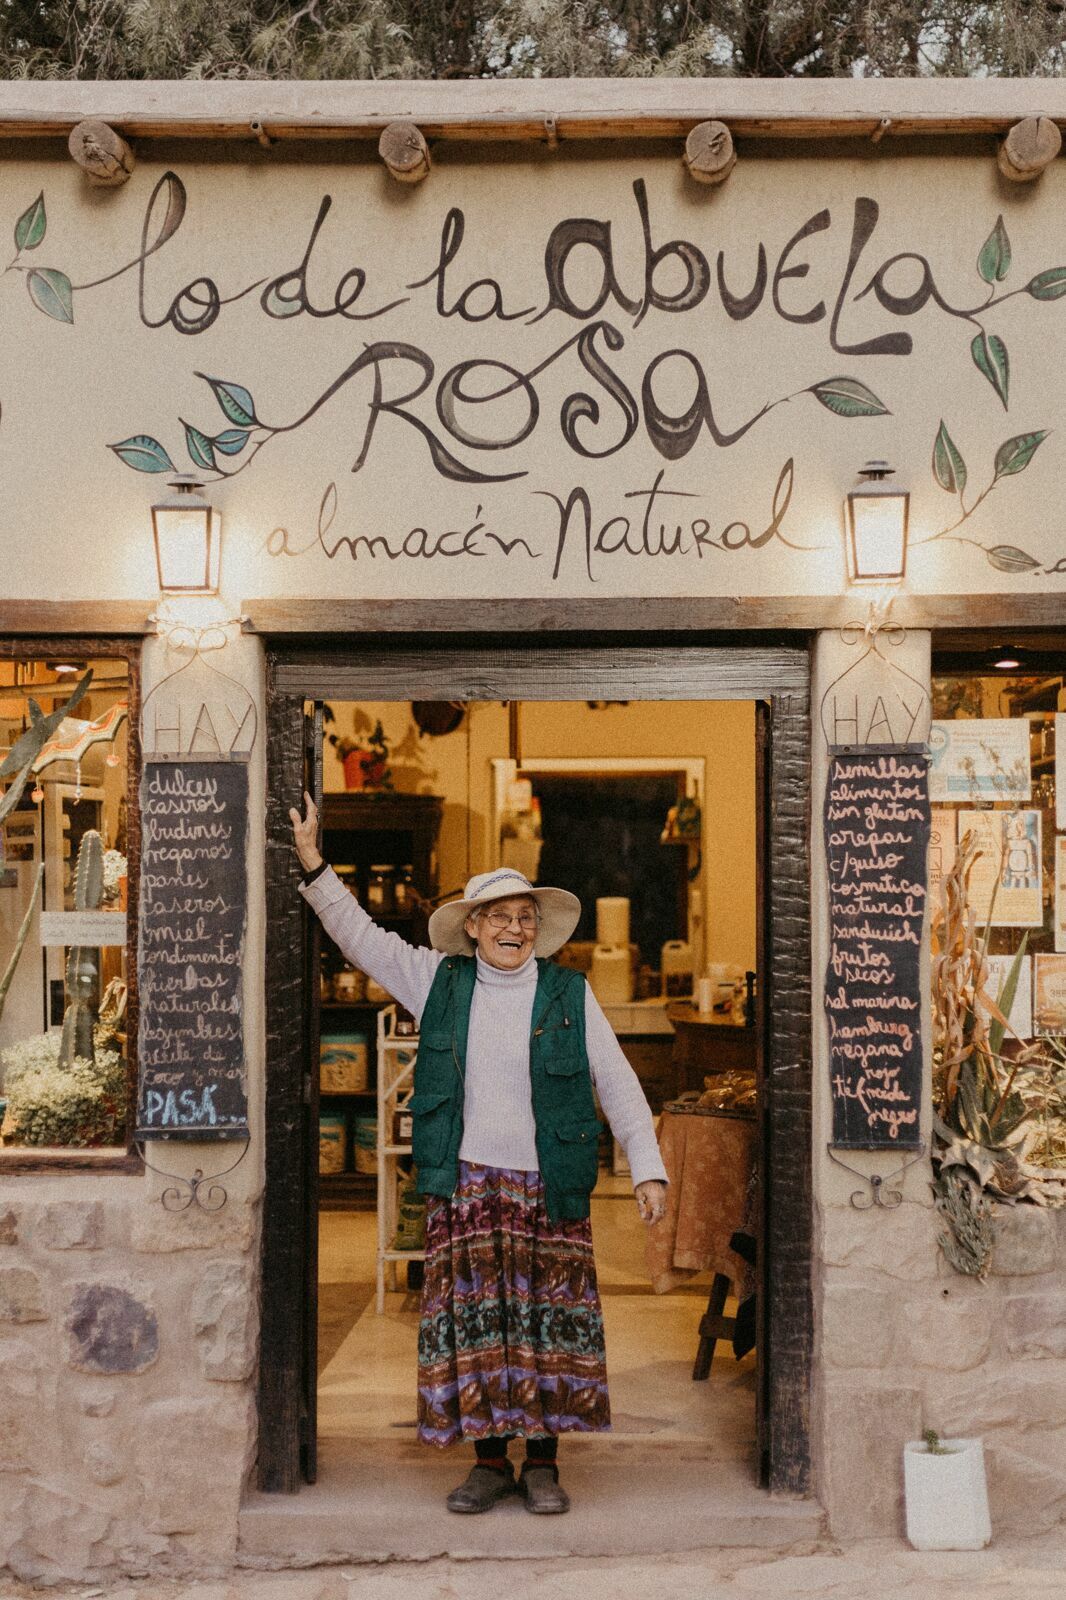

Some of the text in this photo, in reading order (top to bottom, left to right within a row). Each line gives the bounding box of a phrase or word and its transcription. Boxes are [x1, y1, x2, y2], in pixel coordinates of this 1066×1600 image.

[138, 170, 226, 335] lo
[260, 194, 410, 321] de
[407, 207, 538, 323] la
[266, 482, 543, 562] almacén
[154, 702, 253, 752] HAY
[833, 693, 924, 744] HAY
[832, 757, 926, 780] semillas
[149, 769, 217, 797] dulces
[830, 780, 926, 801] alimentos
[147, 796, 226, 815] caseros
[827, 802, 860, 820] sin
[864, 802, 925, 830] gluten
[149, 818, 232, 841] budines
[829, 830, 912, 857] arepas
[830, 851, 904, 878] c/queso
[143, 873, 209, 904] panes
[143, 893, 231, 916] caseros
[832, 896, 922, 917] natural
[145, 916, 212, 945] miel
[833, 920, 919, 945] sandwich
[144, 938, 241, 966] condimentos
[831, 942, 891, 976] frutos
[145, 965, 229, 993] hierbas
[845, 968, 895, 984] secos
[148, 991, 241, 1016] naturales
[826, 986, 918, 1010] sal marina
[143, 1013, 239, 1050] legumbres
[144, 1040, 226, 1065] aceite de
[831, 1044, 904, 1068] vegana
[865, 1062, 900, 1090] rojo
[868, 1107, 917, 1138] negro
